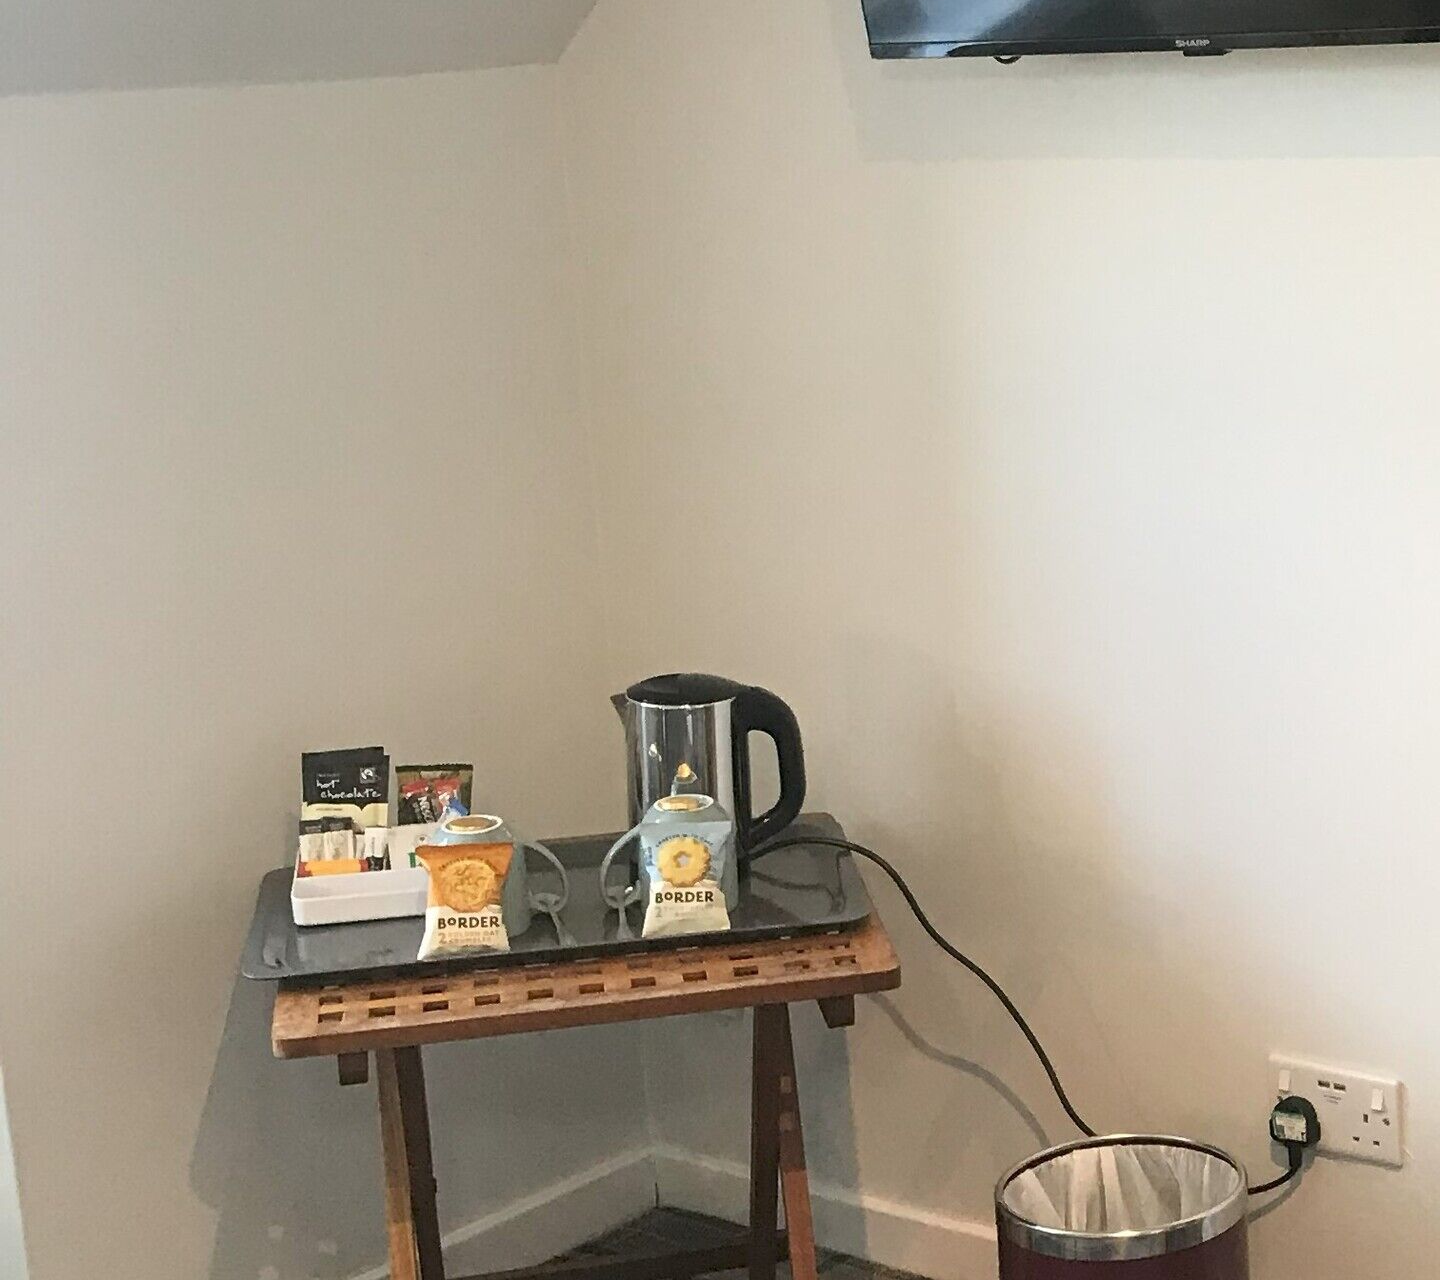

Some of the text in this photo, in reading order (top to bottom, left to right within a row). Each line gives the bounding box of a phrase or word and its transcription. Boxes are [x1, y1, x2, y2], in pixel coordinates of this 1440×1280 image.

[1175, 39, 1210, 48] SHARP
[316, 779, 340, 789] hot
[320, 787, 382, 799] chocolate
[655, 891, 714, 904] BORDER
[437, 916, 500, 929] BORDER
[438, 932, 447, 944] 2
